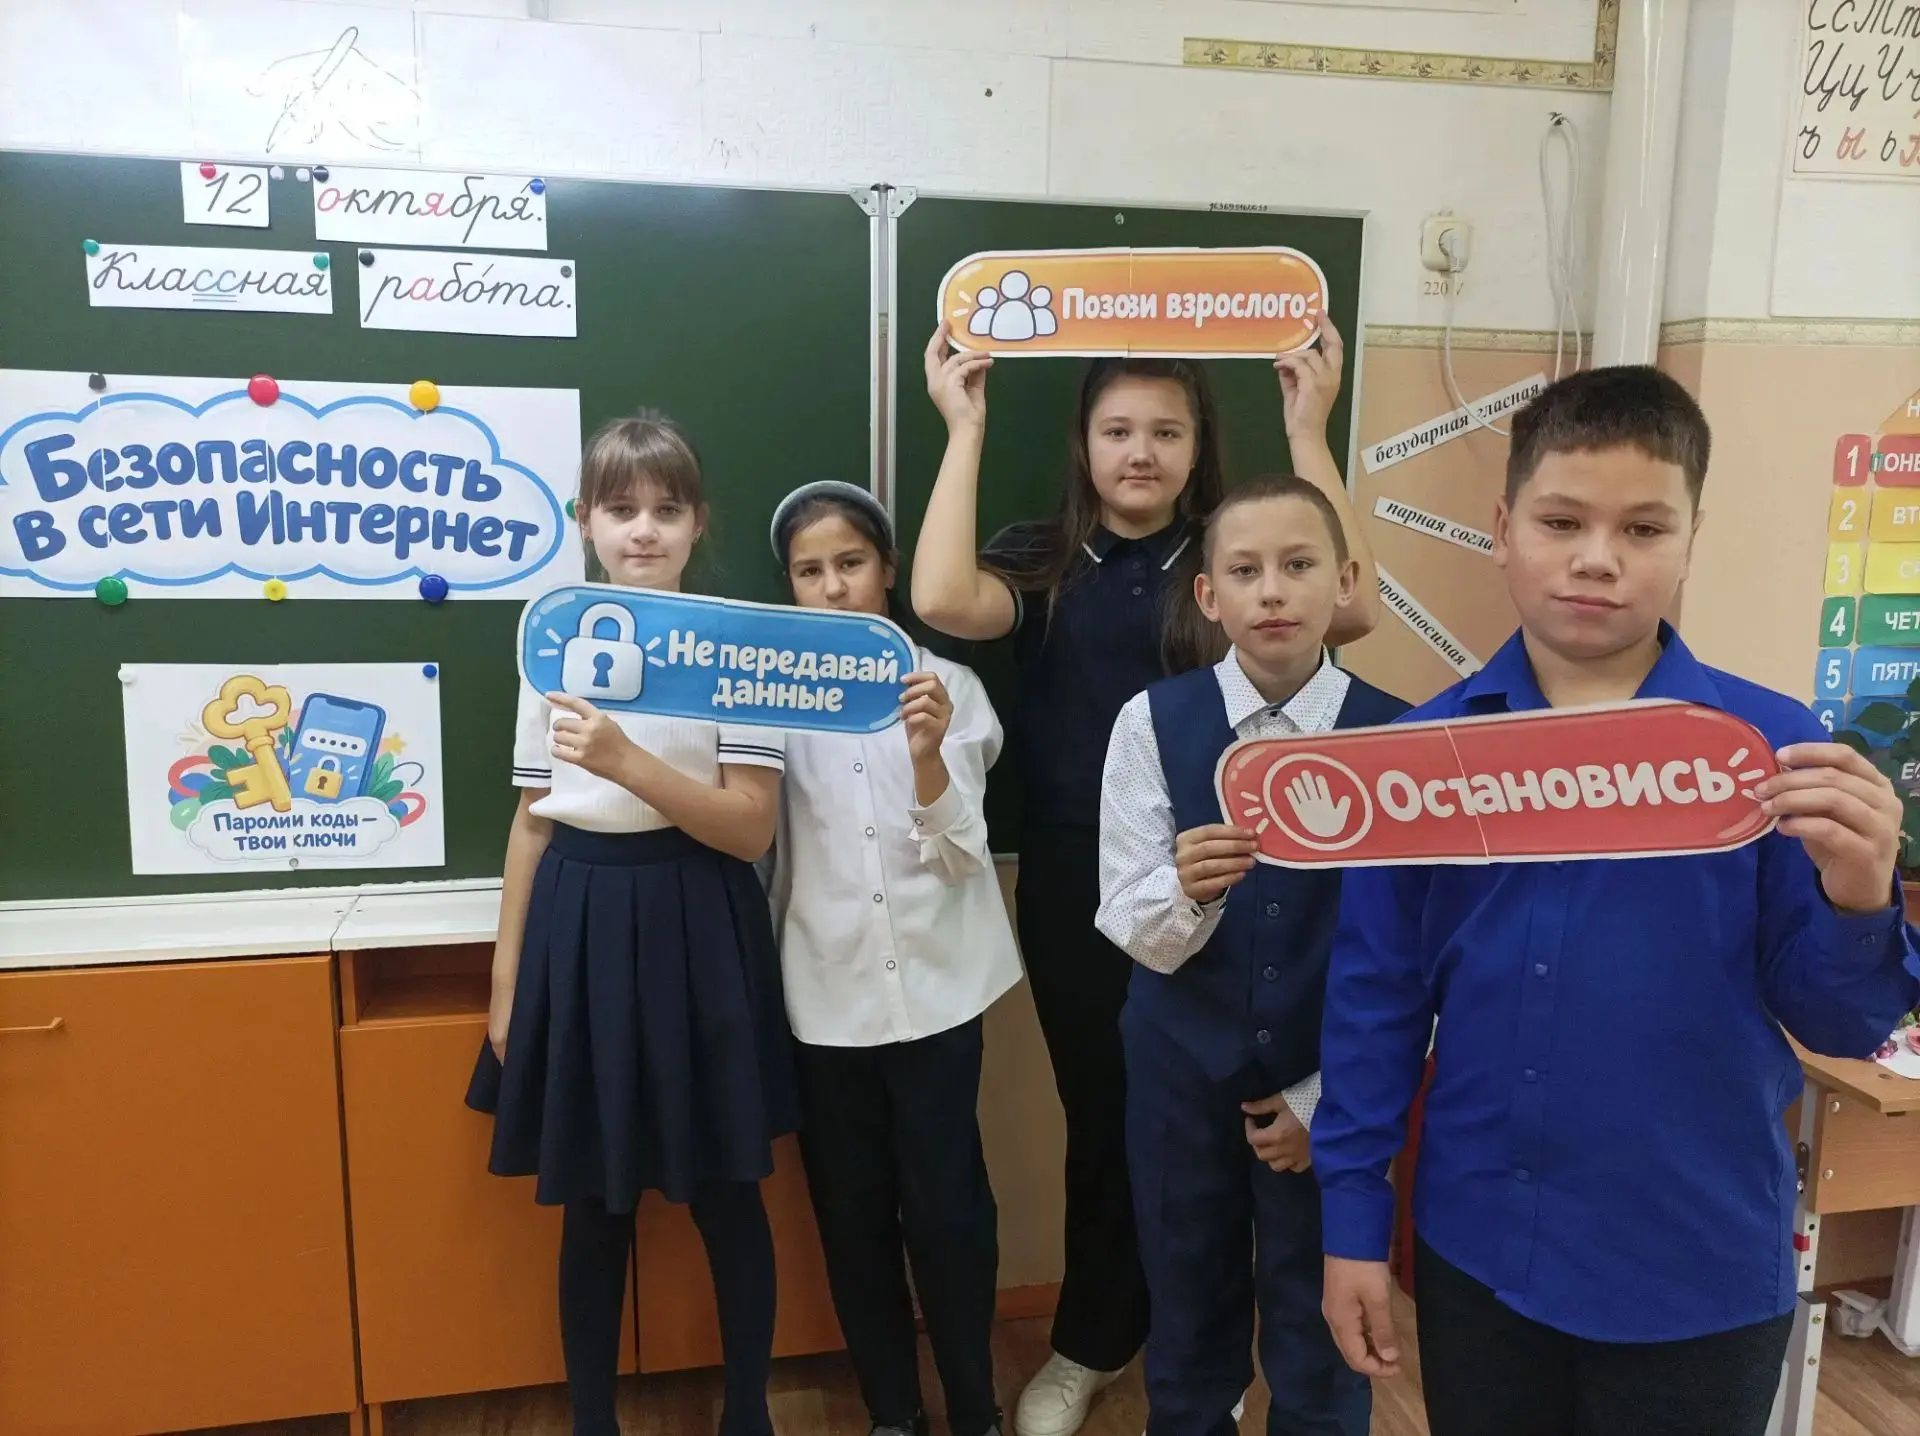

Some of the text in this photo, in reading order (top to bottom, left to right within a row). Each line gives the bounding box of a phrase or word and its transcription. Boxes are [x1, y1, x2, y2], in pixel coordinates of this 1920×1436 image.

[205, 172, 262, 213] 12
[93, 251, 328, 297] Классная
[1423, 280, 1449, 296] 220
[1166, 292, 1307, 328] взрослого
[1375, 383, 1541, 463] безударная гласная
[24, 434, 503, 502] Безопасность
[1847, 445, 1859, 477] 1
[13, 489, 540, 562] в сети Интернет
[1386, 503, 1447, 533] парная
[1838, 500, 1920, 531] 2 ВТ
[1835, 554, 1850, 585] 3
[1829, 606, 1846, 638] 4
[667, 629, 899, 685] Не передавай
[1825, 659, 1842, 690] 5
[711, 677, 845, 713] данные
[1376, 757, 1736, 822] Остановись
[310, 813, 359, 830] коды
[233, 832, 357, 851] твои ключи
